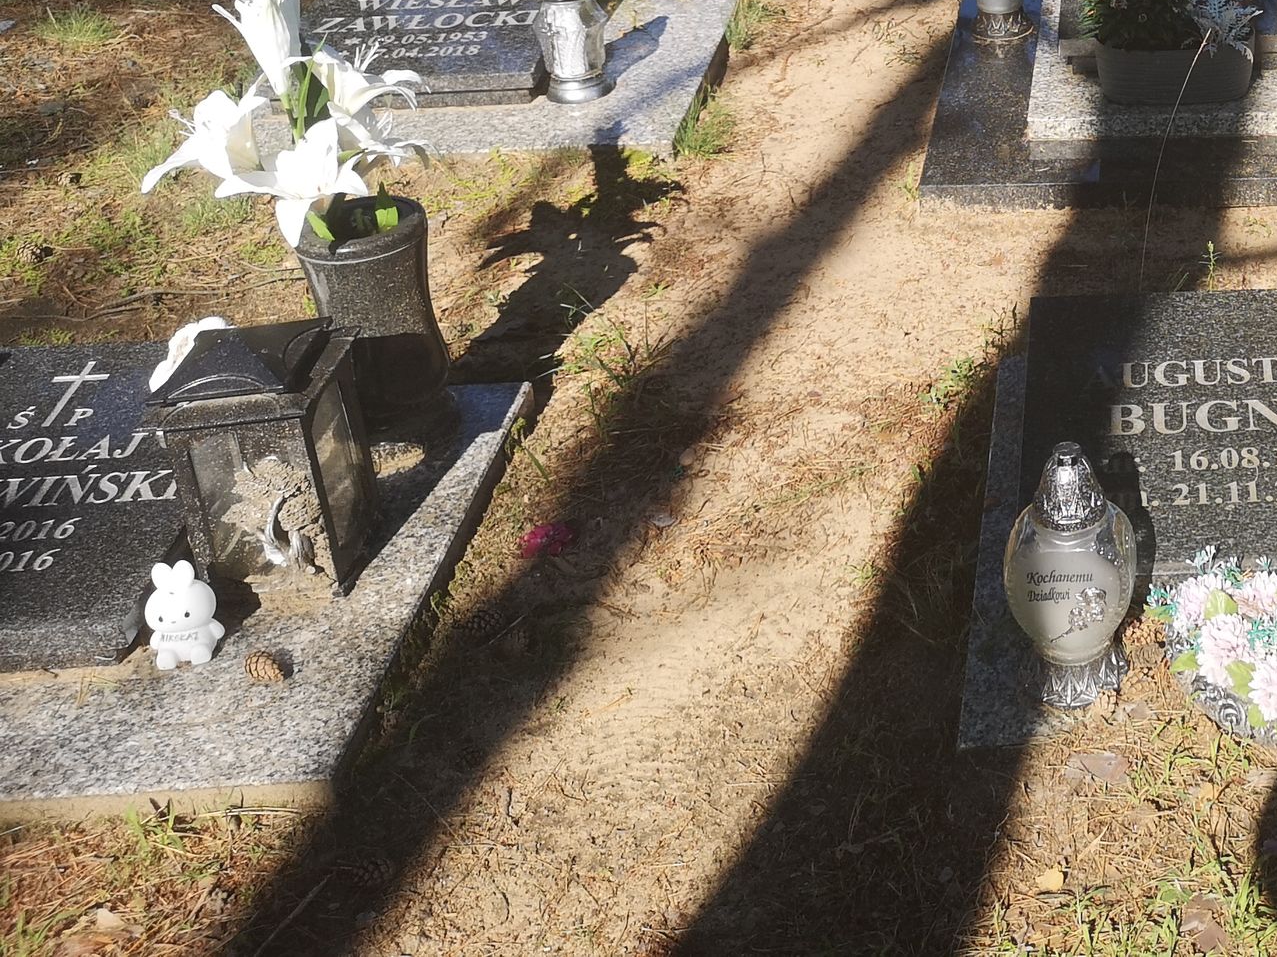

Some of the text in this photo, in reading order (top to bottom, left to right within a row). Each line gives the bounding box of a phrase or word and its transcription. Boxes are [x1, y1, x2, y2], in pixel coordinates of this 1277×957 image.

[312, 9, 542, 34] ZAWŁOCKI
[6, 406, 94, 429] Ś P
[1026, 569, 1093, 586] Kochanemu
[1027, 586, 1071, 604] Dziadkowi
